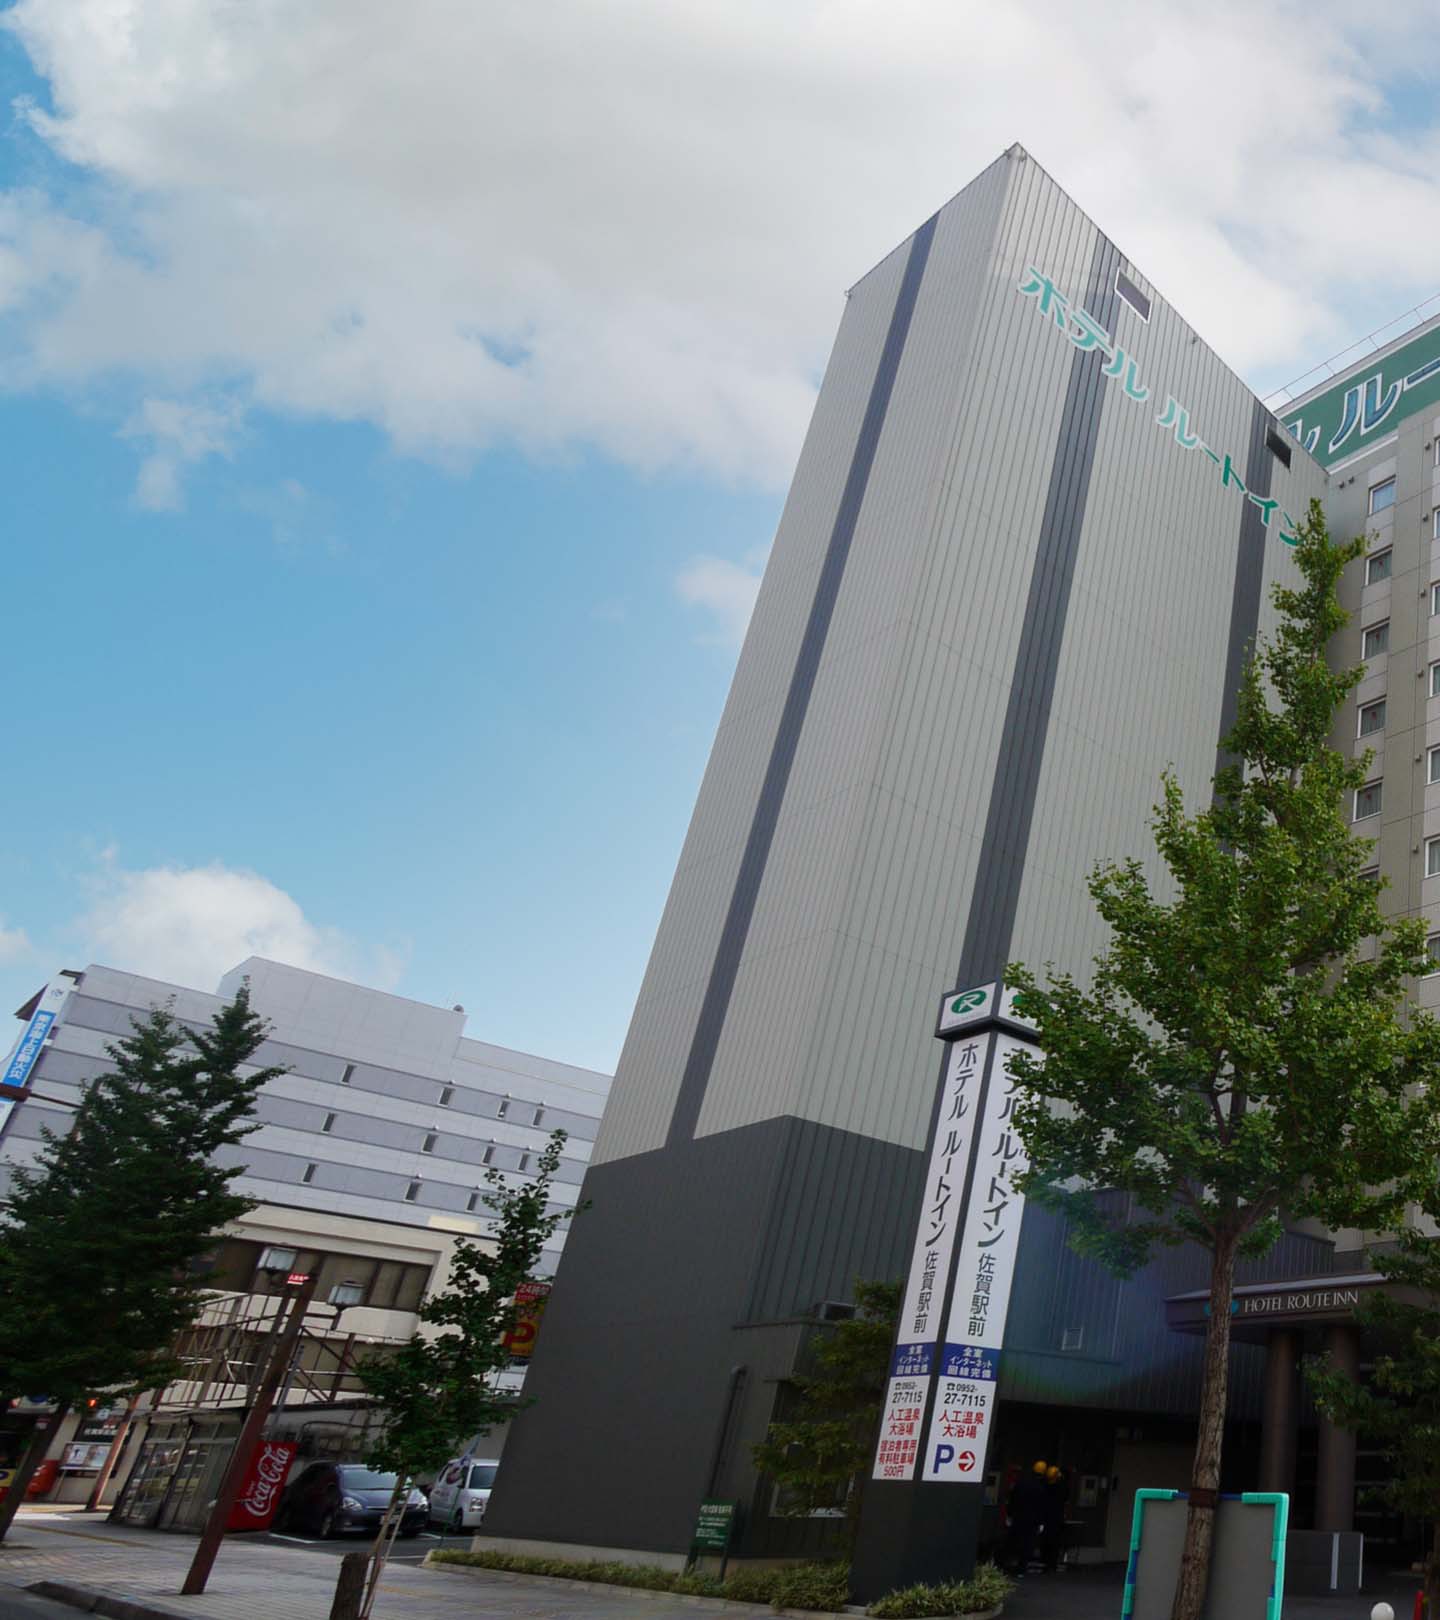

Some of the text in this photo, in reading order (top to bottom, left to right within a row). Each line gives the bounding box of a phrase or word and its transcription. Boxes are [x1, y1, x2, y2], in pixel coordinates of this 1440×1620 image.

[1018, 266, 1149, 401] ホテル
[948, 1043, 979, 1120] ホテル
[925, 1130, 962, 1247] ルートイン
[977, 1133, 1019, 1247] ルートイン
[913, 1250, 940, 1334] 佐賀駅前
[968, 1252, 997, 1337] 佐賀駅前
[1244, 1290, 1359, 1313] HOTEL ROUTE INN
[949, 1356, 993, 1369] インターネット
[947, 1366, 992, 1379] 回線完備
[892, 1391, 923, 1404] 27-7115
[944, 1393, 987, 1407] 27-7115
[888, 1408, 921, 1421] 人工温泉
[938, 1409, 985, 1425] 人工温泉
[888, 1422, 915, 1436] 大浴場
[942, 1425, 978, 1439] 大浴場
[932, 1443, 955, 1474] P
[241, 1444, 290, 1517] Coca-Cola
[883, 1465, 905, 1477] 500円
